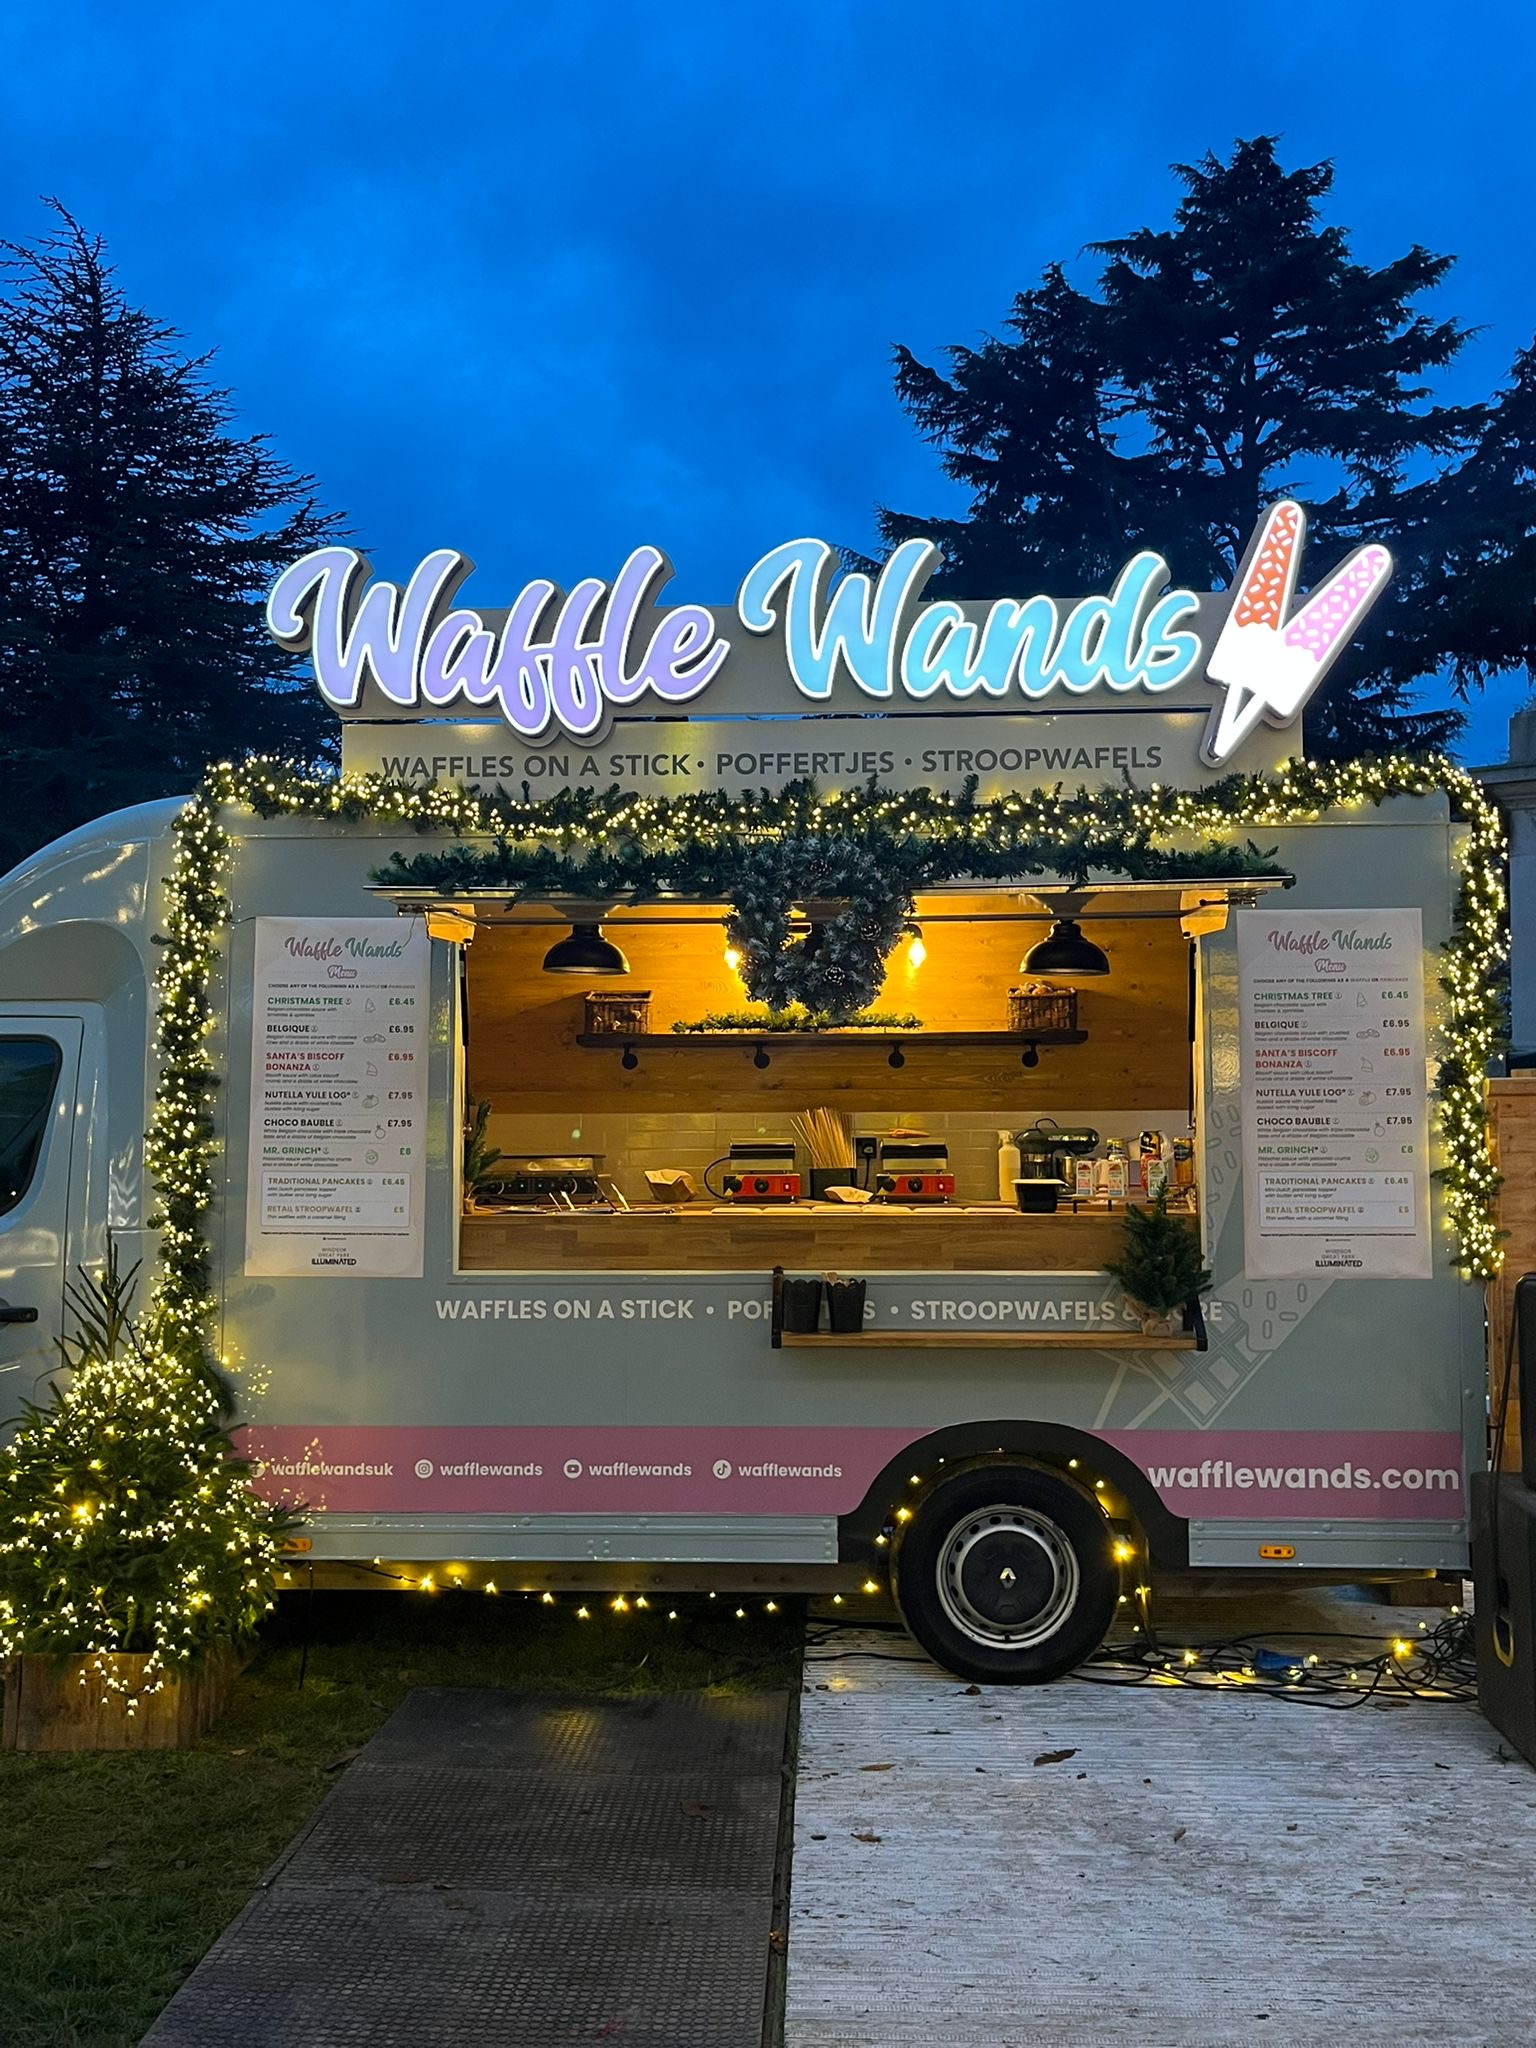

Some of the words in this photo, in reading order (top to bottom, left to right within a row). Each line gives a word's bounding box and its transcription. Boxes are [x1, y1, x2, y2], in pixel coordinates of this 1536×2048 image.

[267, 545, 729, 739] Waffle
[737, 537, 1202, 700] Wands
[381, 756, 514, 778] WAFFLES
[524, 755, 569, 776] ON
[579, 755, 600, 776] A
[610, 753, 691, 776] STICK
[717, 751, 895, 775] POFFERTJES
[922, 746, 1162, 772] STROOPWAFELS
[284, 936, 343, 961] Waffle
[344, 936, 402, 959] Wands
[1267, 930, 1330, 955] Waffle
[1332, 929, 1392, 950] Wands
[327, 964, 358, 979] Menu
[1314, 958, 1347, 973] Menu
[267, 997, 321, 1005] CHRISTMAS
[322, 997, 344, 1005] TREE
[388, 998, 415, 1006] £6.45
[1253, 992, 1309, 1000] CHRISTMAS
[1312, 992, 1333, 1000] TREE
[1381, 991, 1409, 999] £6.45
[266, 1024, 310, 1033] BELGIQUE
[388, 1025, 415, 1033] £6.95
[1254, 1021, 1299, 1029] BELGIQUE
[266, 1052, 305, 1061] SANTA'S
[307, 1052, 345, 1061] BISCOFF
[388, 1053, 414, 1061] £6.95
[1255, 1049, 1296, 1057] SANTA'S
[1298, 1049, 1338, 1057] BISCOFF
[1383, 1048, 1410, 1056] £6.95
[265, 1063, 311, 1071] BONANZA
[264, 1091, 303, 1099] NUTELLA
[304, 1091, 327, 1099] YULE
[388, 1091, 413, 1099] £7.95
[1385, 1088, 1412, 1096] £7.95
[264, 1119, 299, 1127] CHOCO
[300, 1119, 334, 1127] BAUBLE
[387, 1119, 412, 1127] £7.95
[1386, 1117, 1413, 1125] £7.95
[435, 1299, 549, 1321] WAFFLES
[553, 1299, 591, 1321] ON
[596, 1299, 616, 1321] A
[620, 1299, 694, 1321] STICK
[911, 1300, 1116, 1321] STROOPWAFELS
[271, 1462, 394, 1476] wafflewandsuk
[440, 1462, 543, 1477] wafflewands
[588, 1463, 692, 1477] wafflewands
[738, 1463, 843, 1478] wafflewands
[1148, 1460, 1459, 1489] wafflewands.com
